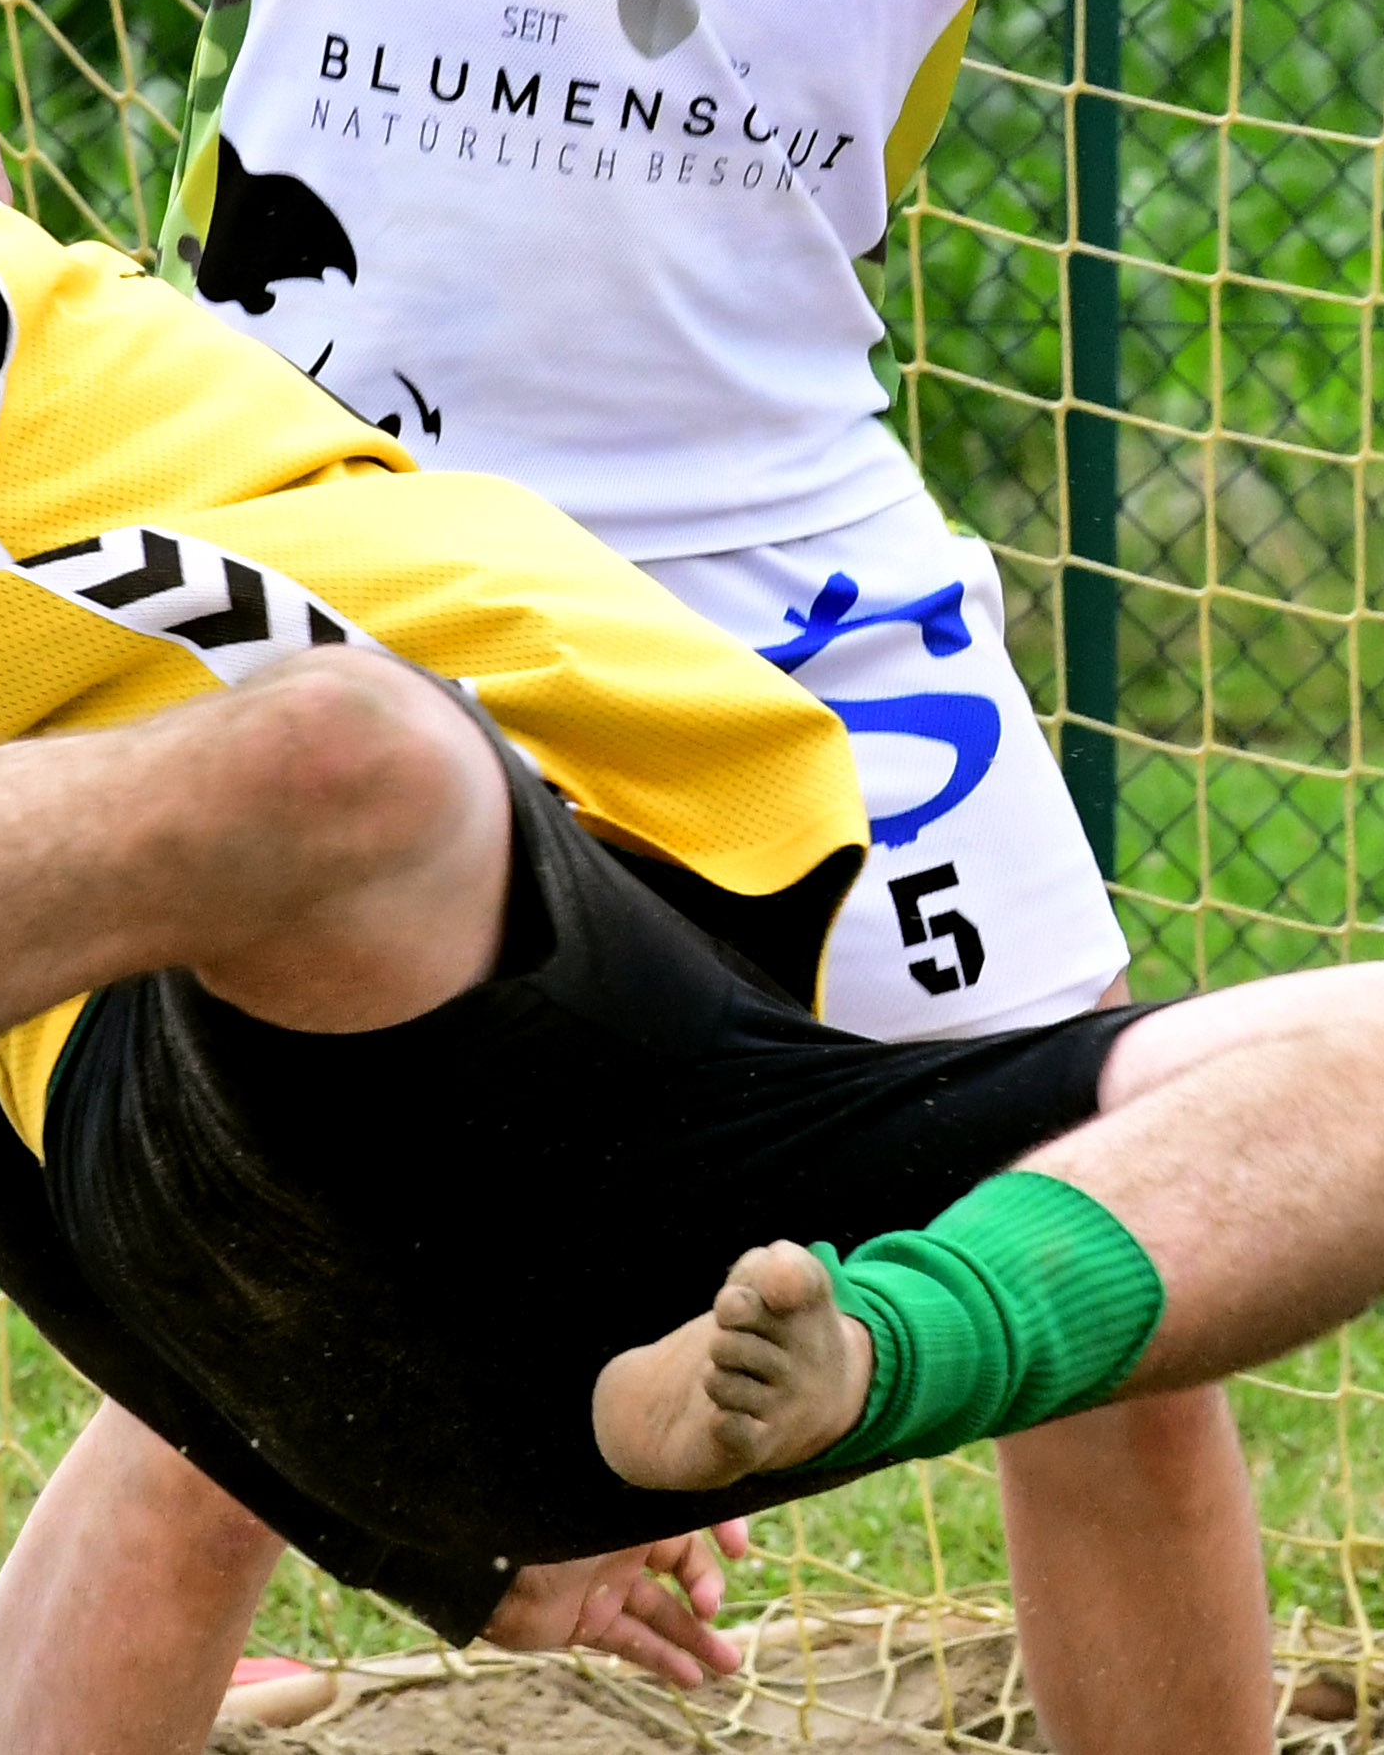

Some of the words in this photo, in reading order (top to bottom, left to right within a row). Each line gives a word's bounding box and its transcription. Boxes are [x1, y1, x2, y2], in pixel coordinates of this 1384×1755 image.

[501, 5, 568, 46] SEIT
[310, 98, 618, 183] NATÜRLICH
[888, 862, 986, 996] 5
